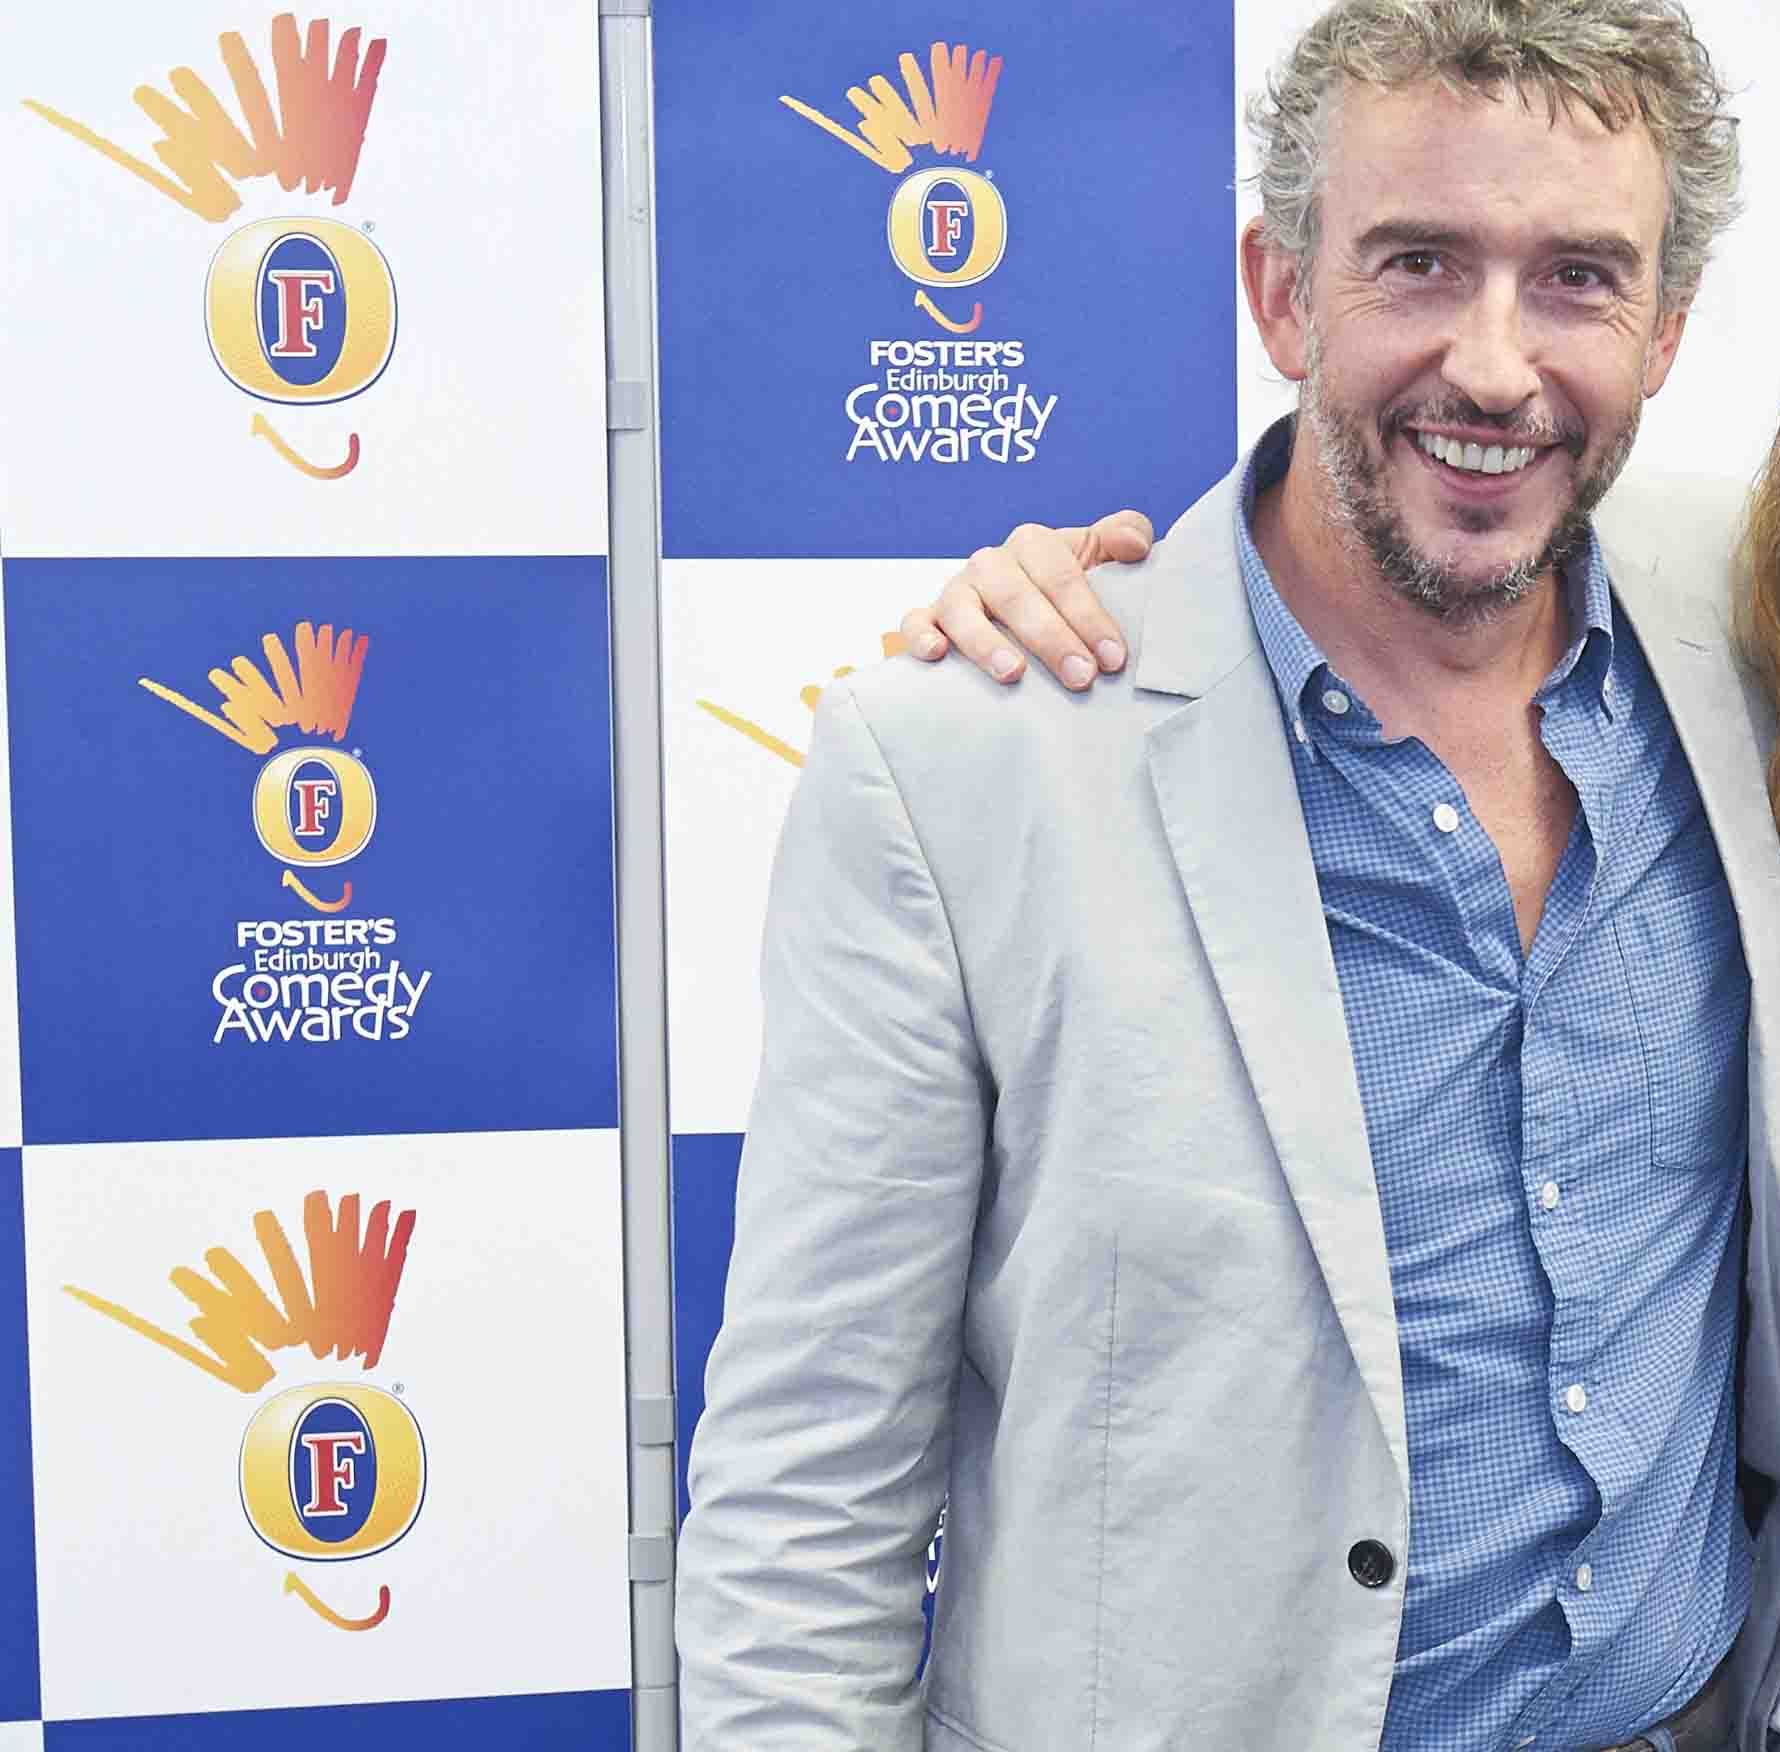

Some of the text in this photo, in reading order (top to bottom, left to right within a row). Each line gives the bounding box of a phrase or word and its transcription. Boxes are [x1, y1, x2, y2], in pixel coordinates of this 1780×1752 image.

[871, 341, 1024, 366] FOSTER'S
[887, 369, 1008, 395] Edinburgh
[845, 384, 1057, 440] Comedy
[845, 418, 1036, 463] Awards
[238, 918, 395, 947] FOSTER'S
[255, 948, 380, 975] Edinburgh
[212, 960, 432, 1016] Comedy
[213, 997, 410, 1044] Awards
